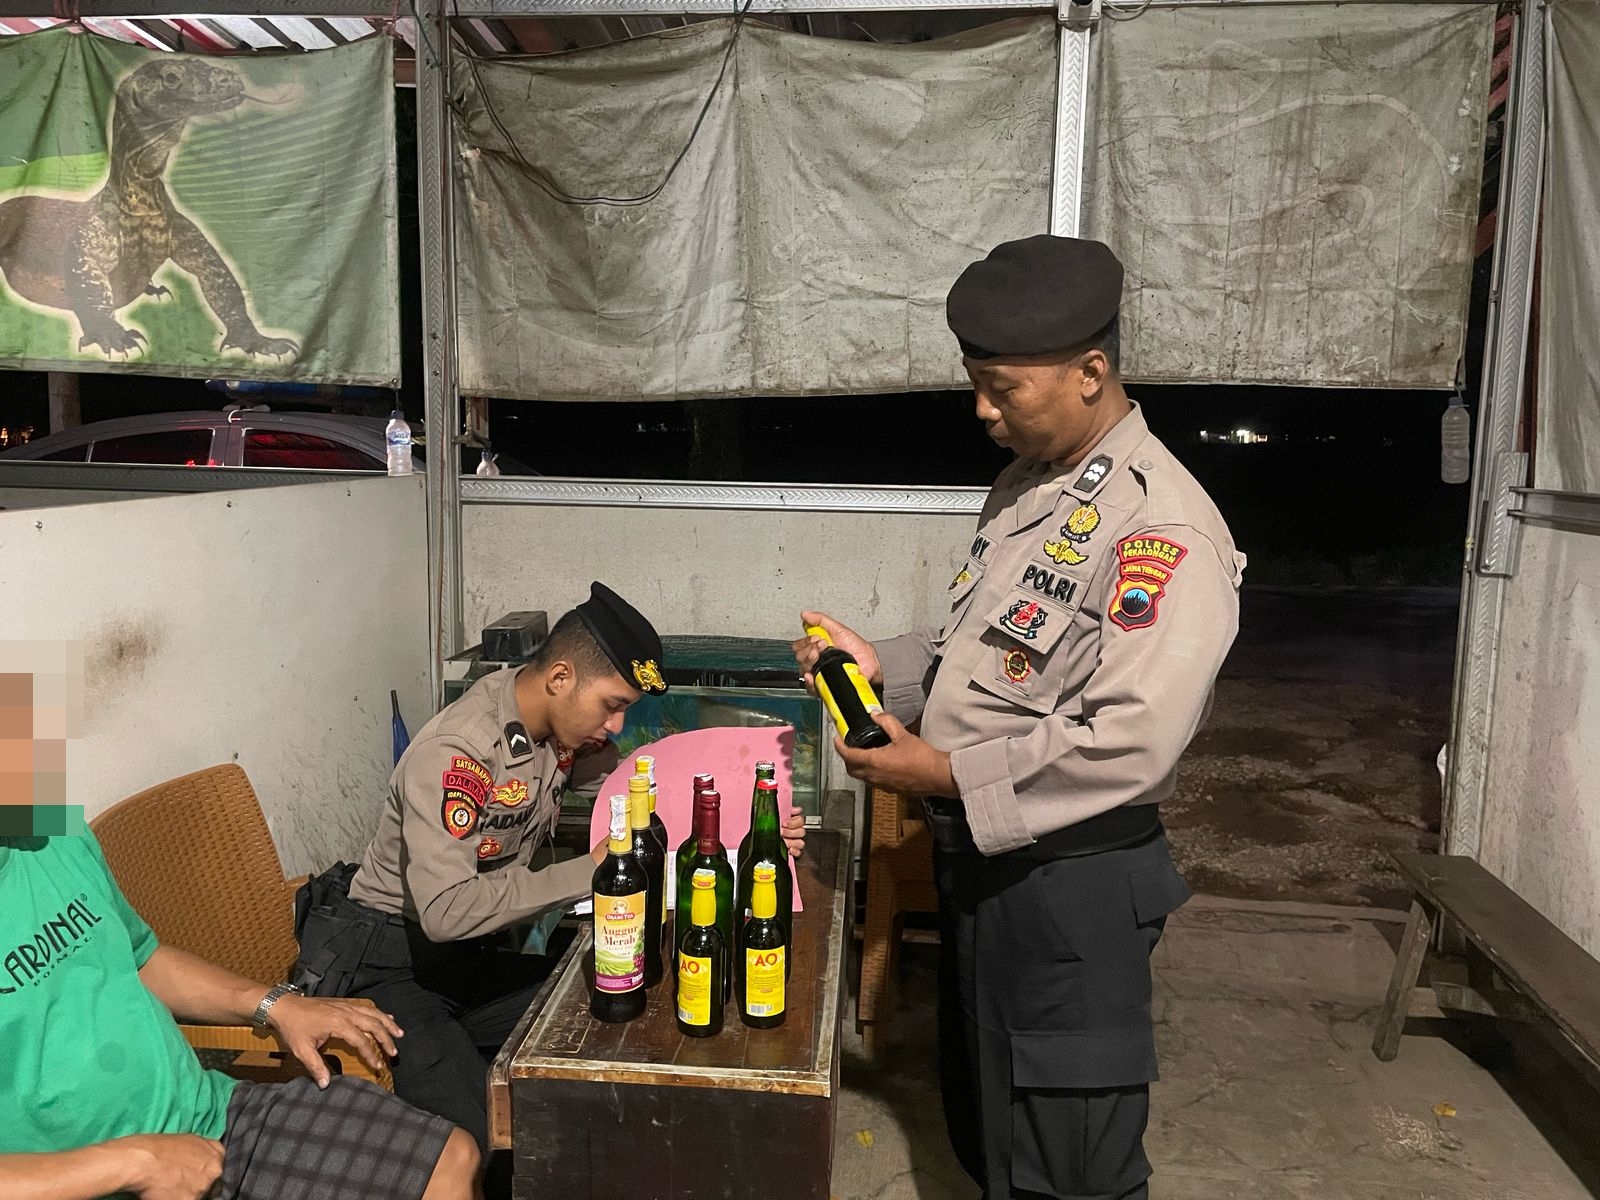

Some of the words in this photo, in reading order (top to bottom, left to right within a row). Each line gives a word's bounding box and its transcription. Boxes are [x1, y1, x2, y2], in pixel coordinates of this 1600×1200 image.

[1123, 547, 1176, 564] PEKALONGAN
[1124, 540, 1179, 556] POLRES
[1123, 564, 1142, 573] JAWA
[1022, 564, 1078, 603] POLRI
[448, 775, 484, 803] DALMAS
[602, 925, 639, 938] Anggur
[604, 934, 636, 946] Merah
[681, 958, 700, 975] AO
[755, 953, 778, 967] AO
